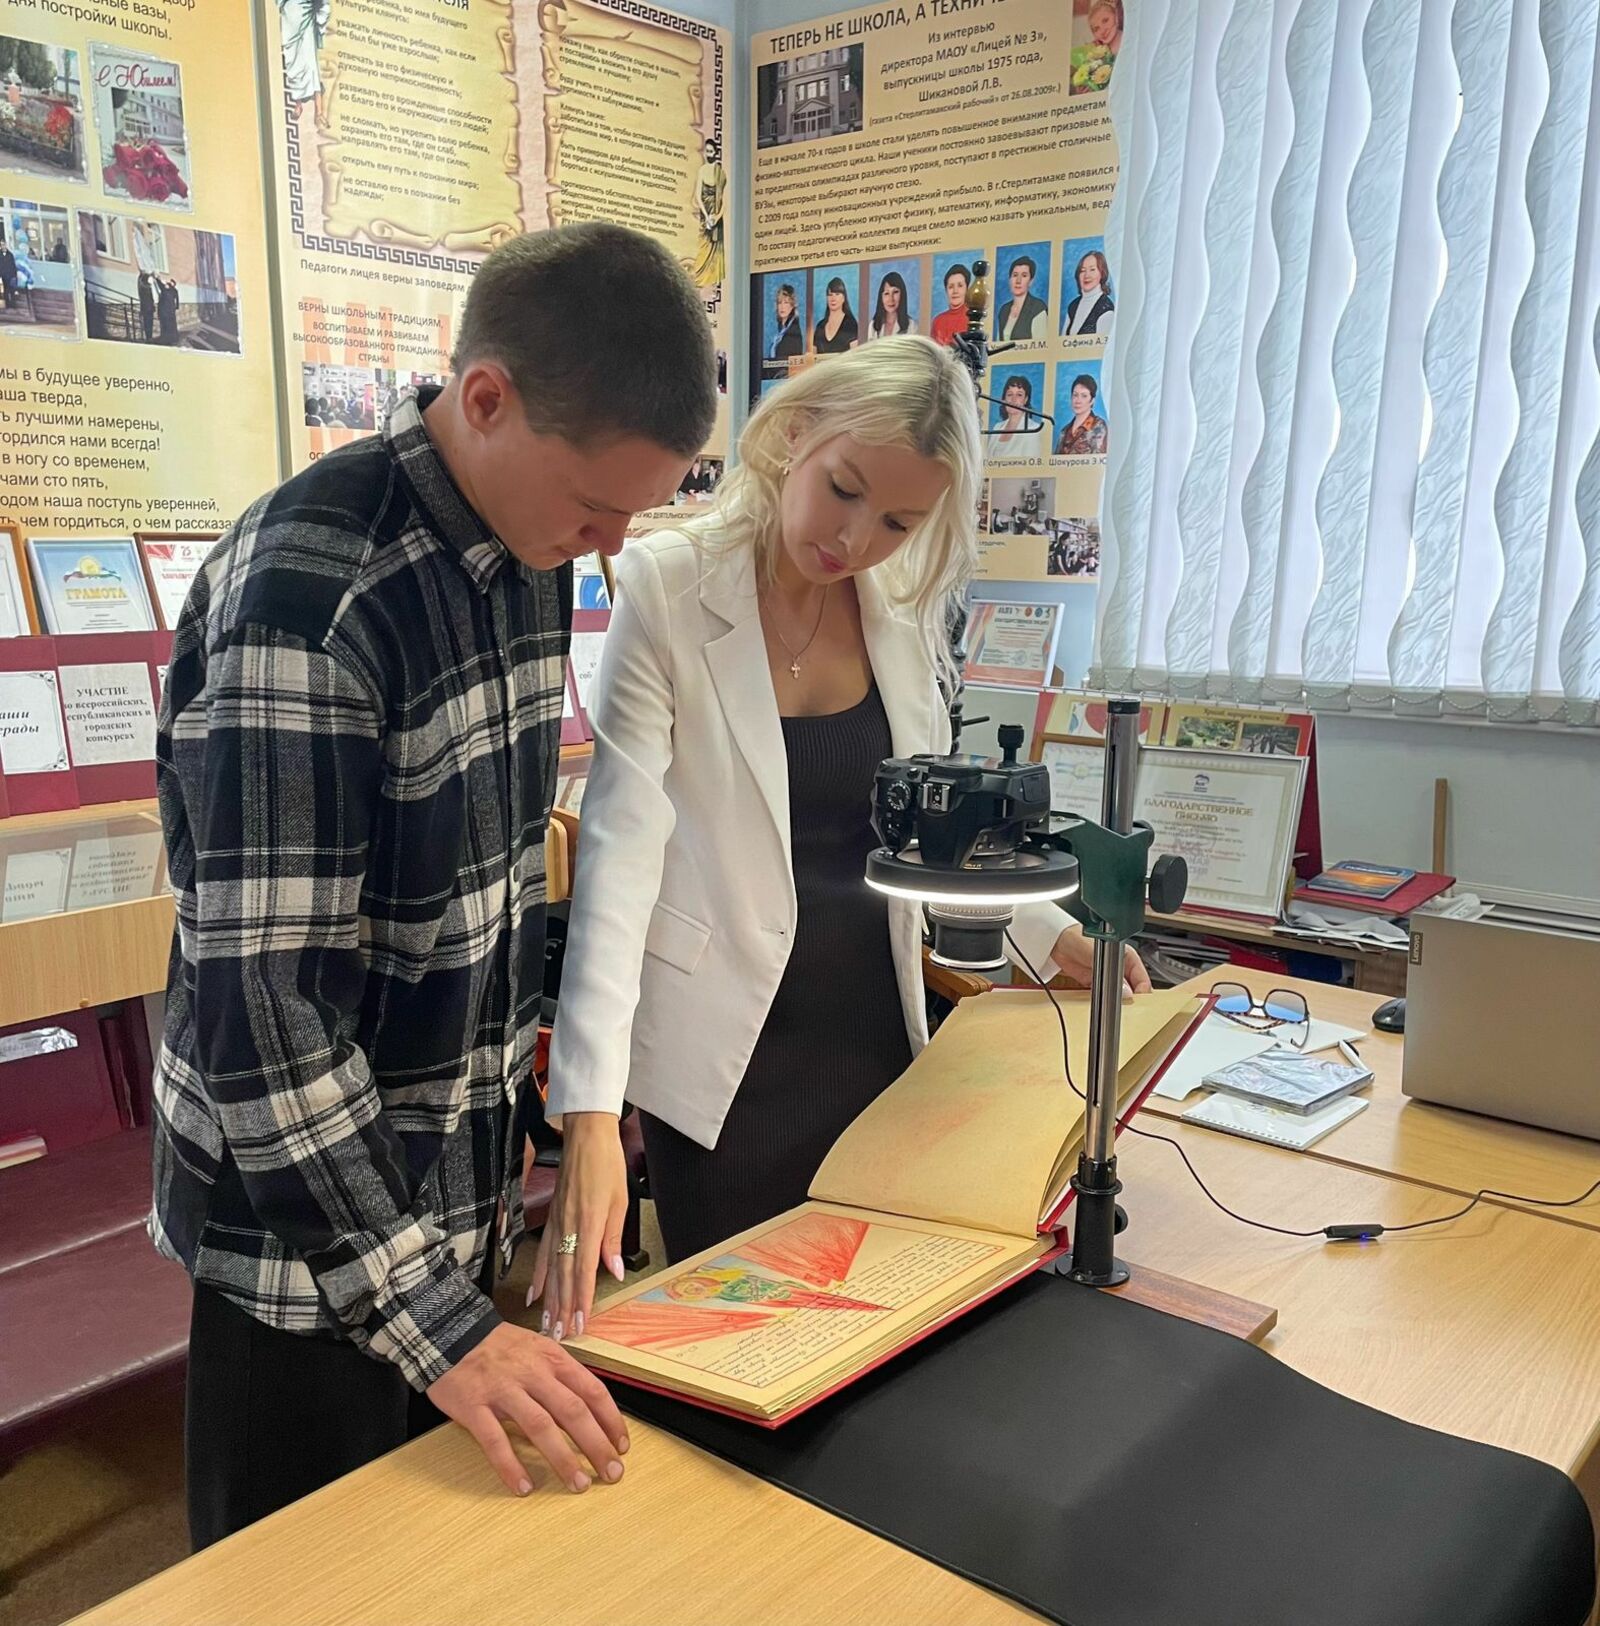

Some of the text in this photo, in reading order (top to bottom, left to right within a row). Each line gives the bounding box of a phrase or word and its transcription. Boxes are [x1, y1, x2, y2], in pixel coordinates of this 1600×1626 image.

[41, 0, 172, 40] постройки школы.
[133, 2, 171, 23] вазы,
[770, 4, 926, 53] ТЕПЕРЬ НЕ ШКОЛА, А
[928, 24, 995, 43] Из интервью
[881, 32, 1047, 75] директора МАОУ «Лицей № 3»,
[884, 54, 1043, 89] выпускницы школы 1975 года,
[919, 77, 1003, 101] Шикановой Л.В.
[781, 151, 805, 162] начале
[808, 148, 823, 158] 70-х
[825, 145, 846, 157] годов
[849, 143, 853, 151] в
[855, 139, 880, 150] школе
[882, 135, 904, 145] стали
[906, 129, 940, 144] уделять
[942, 118, 999, 134] повышенное
[1002, 110, 1048, 124] внимание
[1051, 100, 1106, 118] предметам
[755, 118, 1099, 183] физико-математического цикла. Наши ученики постоянно завоевывают призовые
[755, 187, 763, 195] на
[765, 180, 809, 196] предметных
[812, 172, 859, 186] олимпиадах
[862, 165, 907, 181] различного
[910, 160, 941, 174] уровня,
[944, 152, 989, 165] поступают
[999, 141, 1056, 159] престижные
[1059, 132, 1111, 147] столичные
[755, 178, 922, 210] ВУЗы, некоторые выбирают научную стезю.
[759, 165, 1113, 223] С 2009 года полку инновационных учреждений прибыло. В г.Стерлитамаке появился
[755, 182, 1115, 241] один лицей. Здесь углубленно изучают физику, математику, информатику, экономику
[759, 203, 1089, 251] По составу педагогический коллектив лицея смело можно назвать уникальным,
[755, 237, 941, 267] практически третья его часть- наши выпускники:
[301, 259, 464, 294] Педагоги лицея верны заповедям
[298, 302, 443, 329] ВЕРНЫ ШКОЛЬНЫМ ТРАДИЦИЯМ,
[293, 332, 395, 351] ВЫСОКООБРАЗОВАННОГО
[313, 320, 429, 342] ВОСПИТЫВАЕМ И РАЗВИВАЕМ
[359, 352, 389, 363] СТРАНЫ
[23, 370, 31, 379] в
[37, 368, 100, 387] будущее
[105, 375, 174, 395] уверенно,
[33, 391, 87, 409] тверда,
[16, 412, 164, 434] лучшими намерены,
[71, 435, 106, 446] нами
[112, 436, 160, 453] всегда!
[3, 453, 150, 473] в ногу со временем,
[44, 475, 67, 485] сто
[73, 476, 108, 492] пять,
[44, 496, 82, 506] наша
[88, 497, 142, 511] поступь
[146, 496, 219, 514] уверенней,
[20, 516, 236, 532] чем гордиться, о чем рассказа
[65, 586, 128, 600] ГРАМОТА
[77, 687, 129, 697] УЧАСТИЕ
[76, 700, 147, 709] всероссийских,
[85, 722, 132, 732] городских
[86, 734, 135, 743] конкурсах
[1144, 798, 1255, 818] БЛАГОДАРСТВЕННОЕ
[1175, 812, 1218, 822] ПИСЬМО
[1411, 934, 1420, 963] Lenovo
